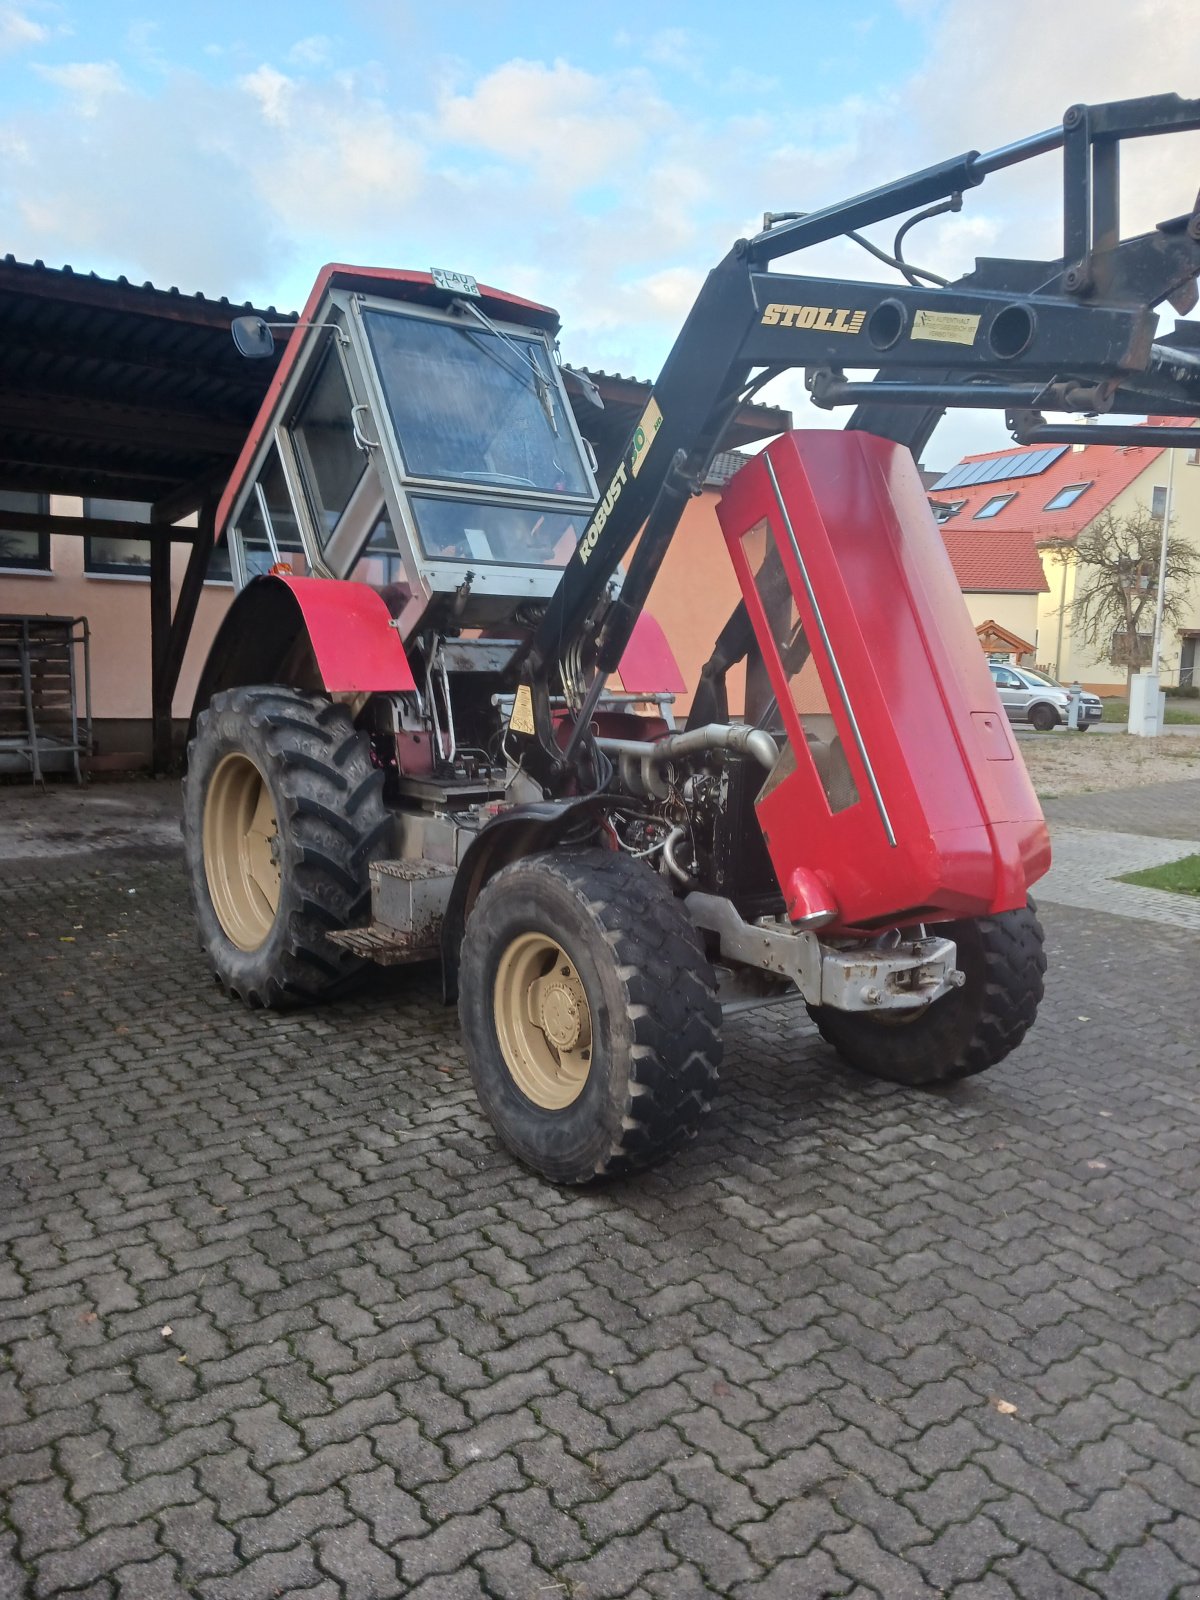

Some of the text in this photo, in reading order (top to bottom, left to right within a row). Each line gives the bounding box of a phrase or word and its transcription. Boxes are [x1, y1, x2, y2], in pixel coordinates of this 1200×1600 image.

[434, 276, 454, 288] YL
[443, 271, 468, 284] LAU
[761, 303, 851, 333] STOLL
[579, 460, 628, 566] ROBUST
